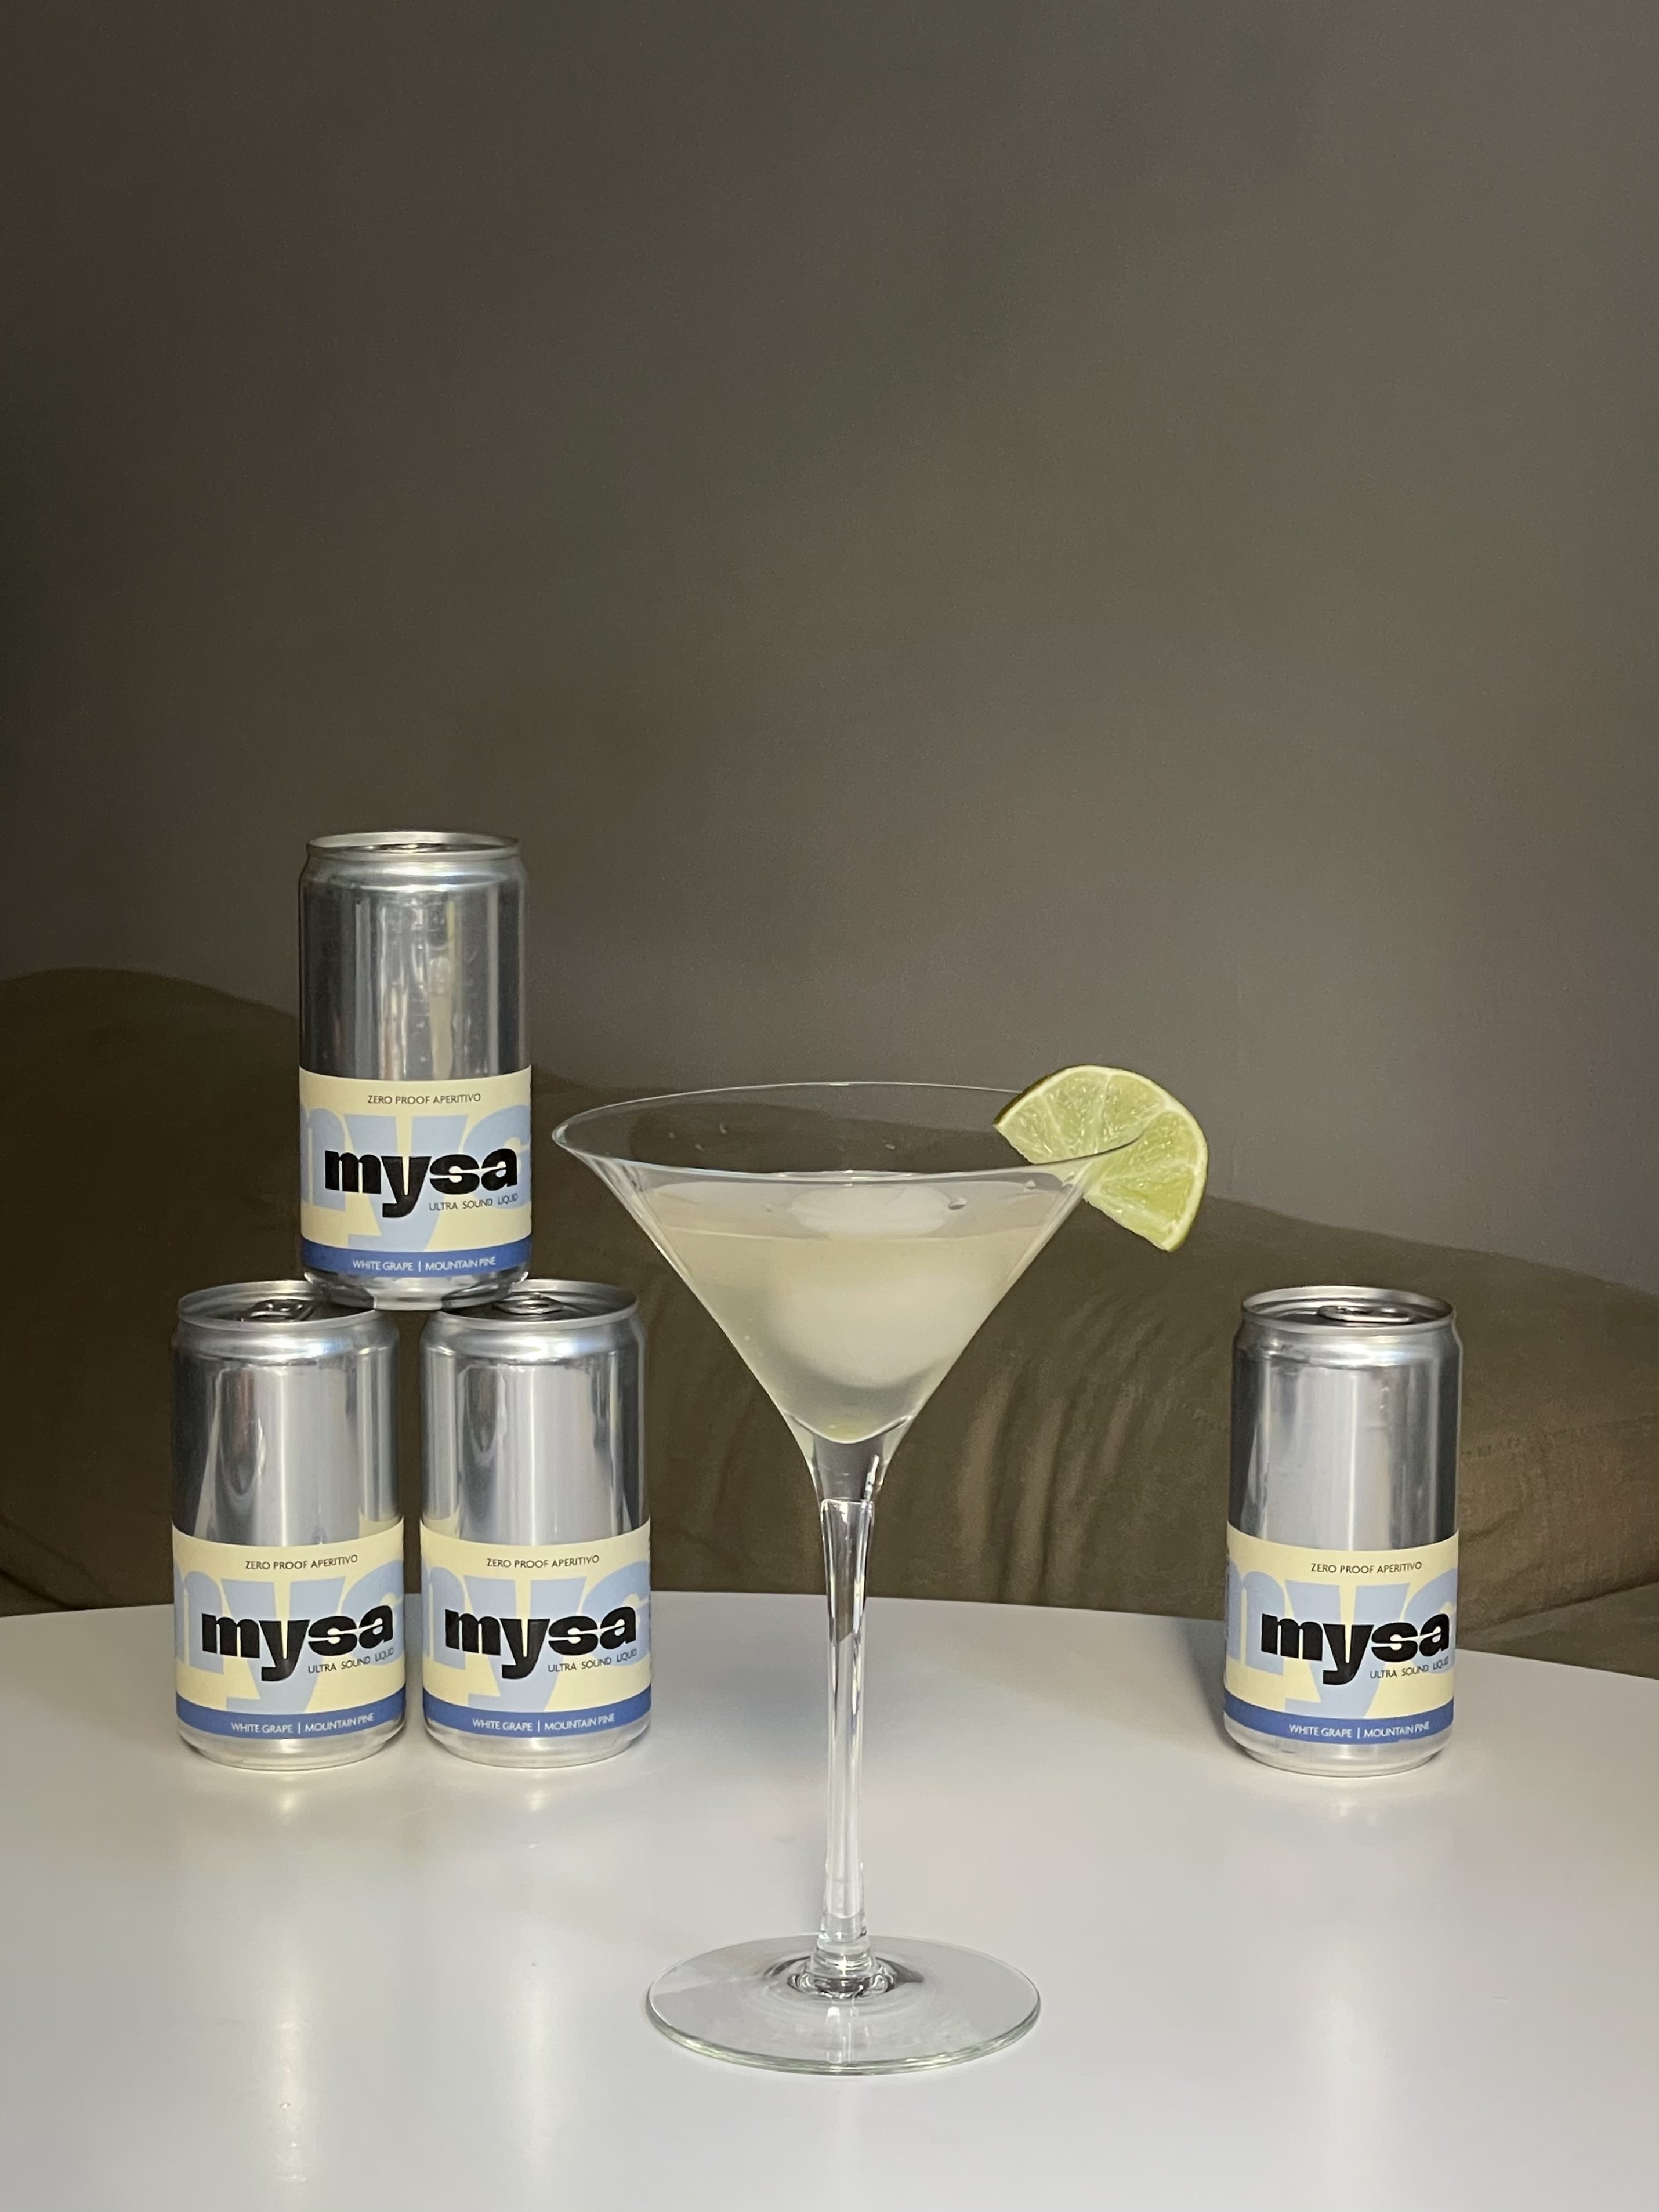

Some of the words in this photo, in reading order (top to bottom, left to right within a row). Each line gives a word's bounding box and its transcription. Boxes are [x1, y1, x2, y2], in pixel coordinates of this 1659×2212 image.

[367, 1095, 392, 1104] ZERO
[396, 1096, 430, 1104] PROOF
[433, 1093, 481, 1104] APERITIVO
[325, 1148, 517, 1217] mysa
[429, 1202, 458, 1211] ULTRA
[463, 1198, 493, 1210] SOUND
[498, 1193, 519, 1205] LIQUID
[353, 1260, 381, 1270] WHITE
[383, 1261, 413, 1271] GRAPE
[425, 1258, 478, 1271] MOUNTAIN
[479, 1257, 496, 1267] PINE
[245, 1561, 270, 1569] ZERO
[273, 1561, 307, 1569] PROOF
[310, 1554, 358, 1569] APERITIVO
[487, 1558, 511, 1568] ZERO
[515, 1559, 549, 1568] PROOF
[552, 1555, 599, 1567] APERITIVO
[1311, 1563, 1337, 1573] ZERO
[1340, 1565, 1374, 1574] PROOF
[1377, 1561, 1422, 1573] APERITIVO
[202, 1605, 393, 1681] mysa
[445, 1606, 636, 1680] mysa
[1261, 1613, 1450, 1685] mysa
[308, 1664, 336, 1674] ULTRA
[342, 1656, 371, 1670] SOUND
[375, 1647, 394, 1661] LIQUID
[548, 1662, 577, 1673] ULTRA
[581, 1657, 612, 1670] SOUND
[616, 1648, 637, 1663] LIQUID
[1370, 1669, 1397, 1679] ULTRA
[1401, 1665, 1429, 1676] SOUND
[231, 1723, 260, 1733] WHITE
[262, 1724, 292, 1734] GRAPE
[305, 1717, 357, 1732] MOUNTAIN
[357, 1713, 374, 1724] PINE
[473, 1718, 501, 1729] WHITE
[502, 1721, 533, 1731] GRAPE
[544, 1717, 597, 1730] MOUNTAIN
[598, 1713, 615, 1724] PINE
[1289, 1724, 1320, 1736] WHITE
[1321, 1727, 1352, 1738] GRAPE
[1364, 1725, 1414, 1738] MOUNTAIN
[1415, 1721, 1430, 1732] PINE
